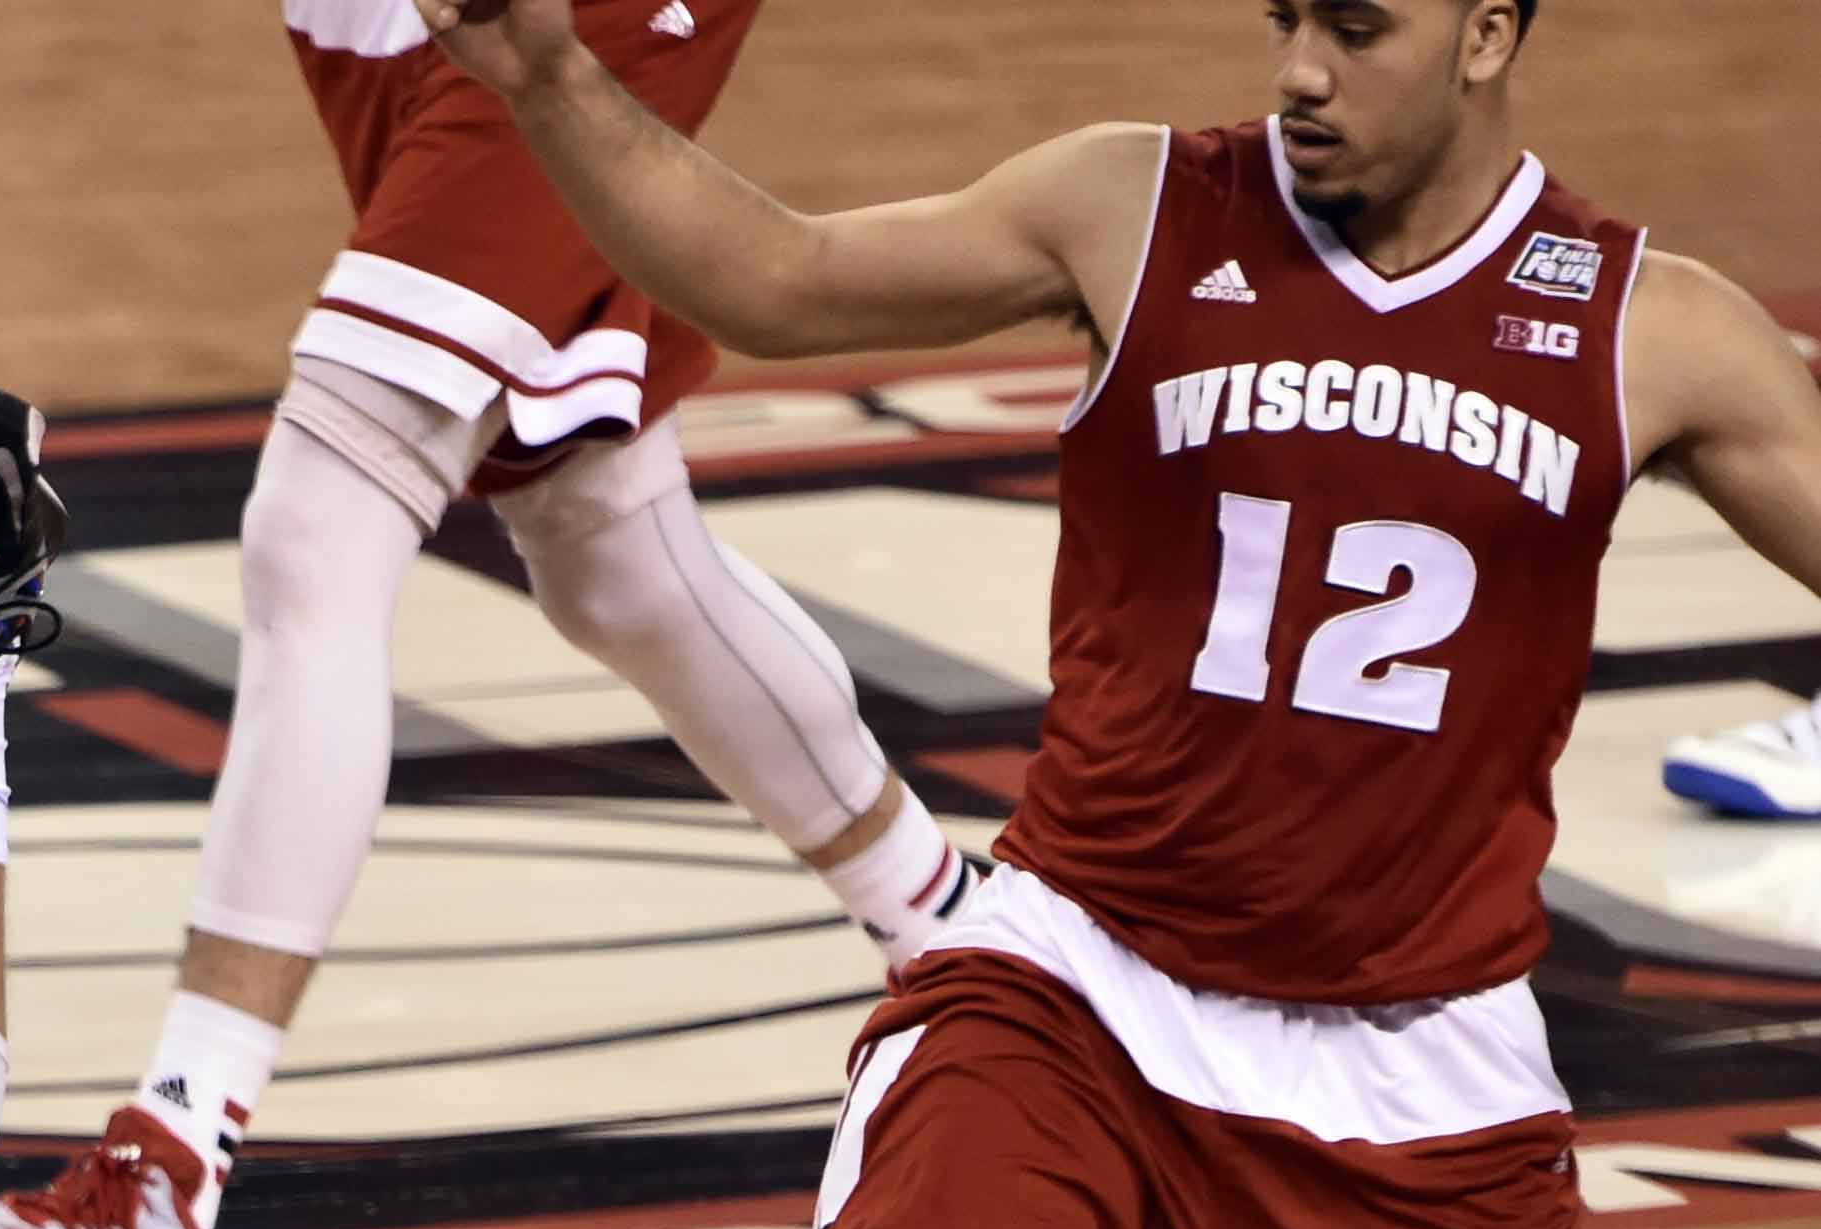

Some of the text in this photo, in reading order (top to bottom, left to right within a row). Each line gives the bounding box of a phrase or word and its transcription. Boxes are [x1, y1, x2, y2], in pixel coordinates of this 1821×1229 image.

[1191, 285, 1257, 303] adidas
[1152, 359, 1581, 518] WISCONSIN
[1190, 491, 1478, 733] 12
